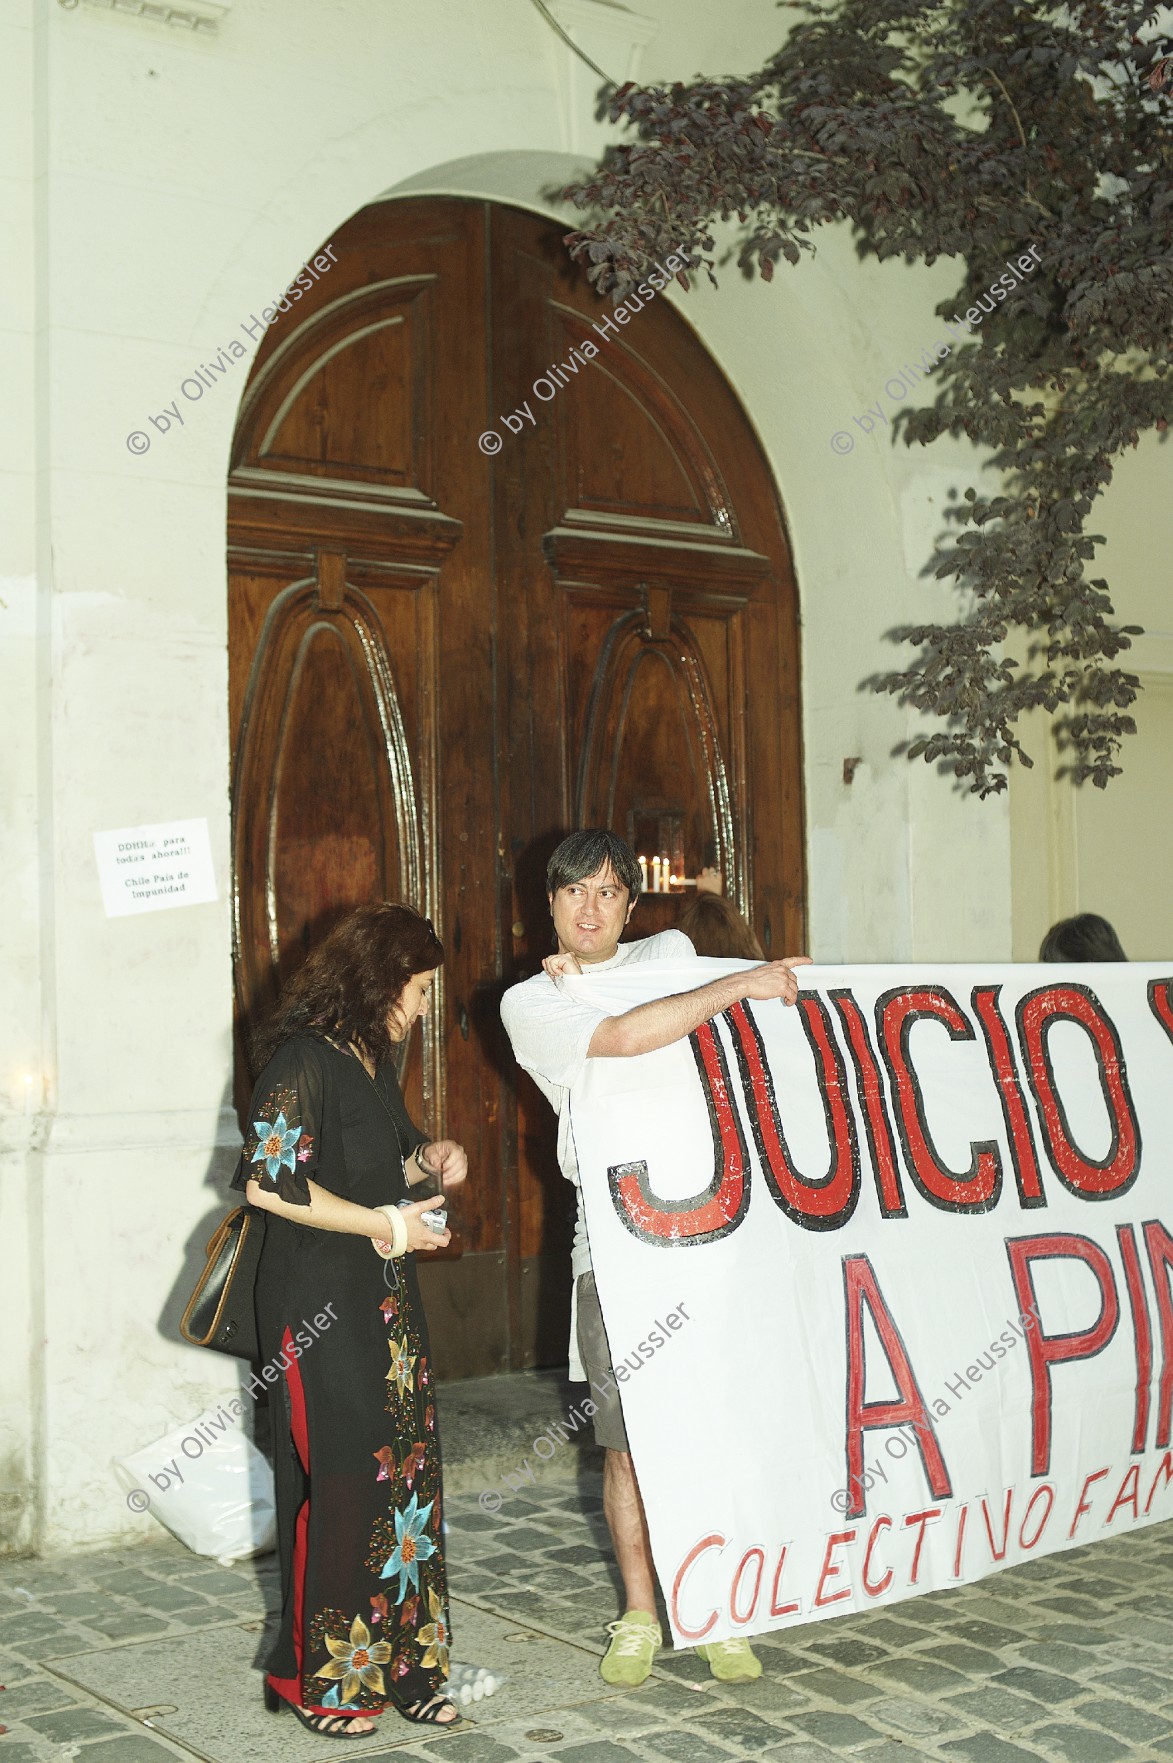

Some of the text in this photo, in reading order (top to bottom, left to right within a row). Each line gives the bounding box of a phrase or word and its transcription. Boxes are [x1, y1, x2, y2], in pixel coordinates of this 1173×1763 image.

[124, 876, 150, 888] Chile
[177, 871, 189, 880] de
[163, 836, 185, 847] para
[132, 883, 186, 898] Impunidad
[606, 983, 1143, 1248] JUICIO
[841, 1252, 953, 1521] A
[671, 1481, 1058, 1640] COLECTIVO
